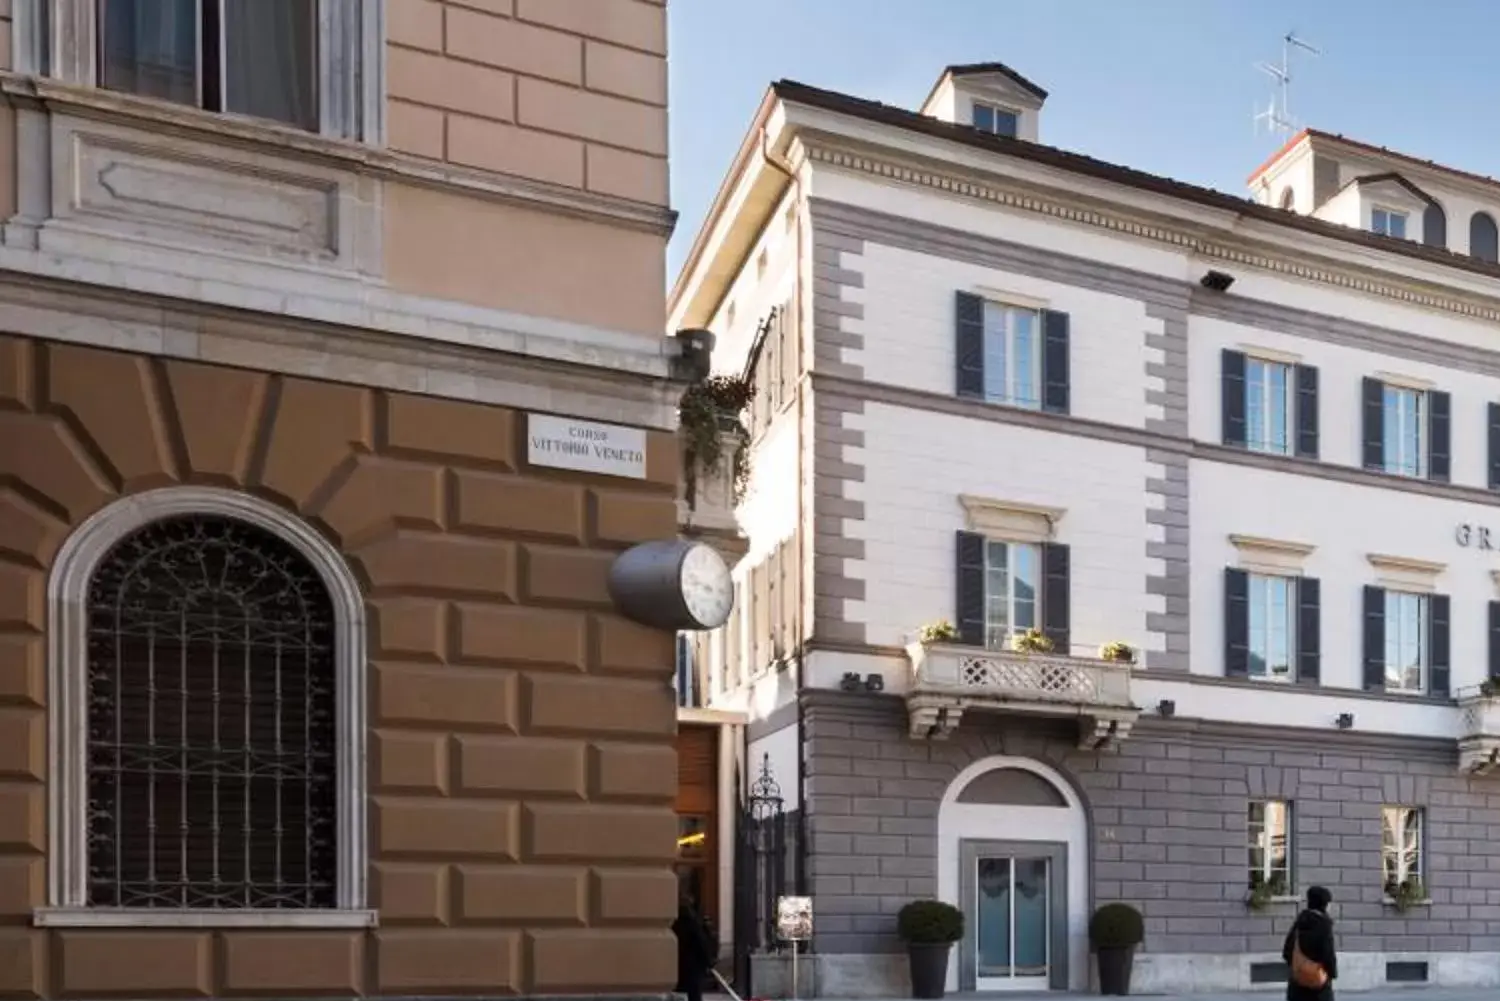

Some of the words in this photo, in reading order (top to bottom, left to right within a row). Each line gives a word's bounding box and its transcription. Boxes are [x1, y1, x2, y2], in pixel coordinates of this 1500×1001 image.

[568, 427, 608, 440] CORSO
[532, 436, 590, 455] VITTORIO
[594, 447, 643, 464] VENETO
